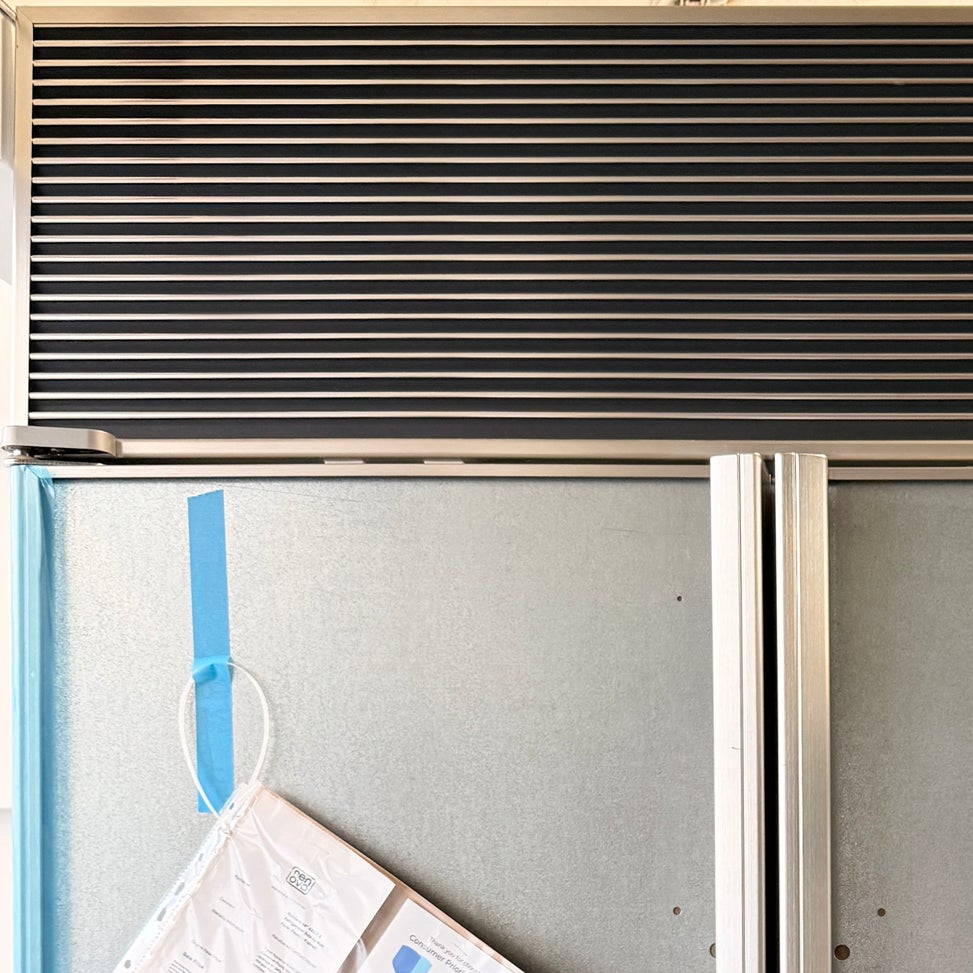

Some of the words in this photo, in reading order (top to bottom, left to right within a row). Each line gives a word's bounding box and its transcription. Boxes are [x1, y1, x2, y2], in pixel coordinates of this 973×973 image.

[408, 933, 446, 963] Consumer
[428, 936, 446, 951] Thank
[444, 948, 456, 960] you
[455, 955, 464, 964] for
